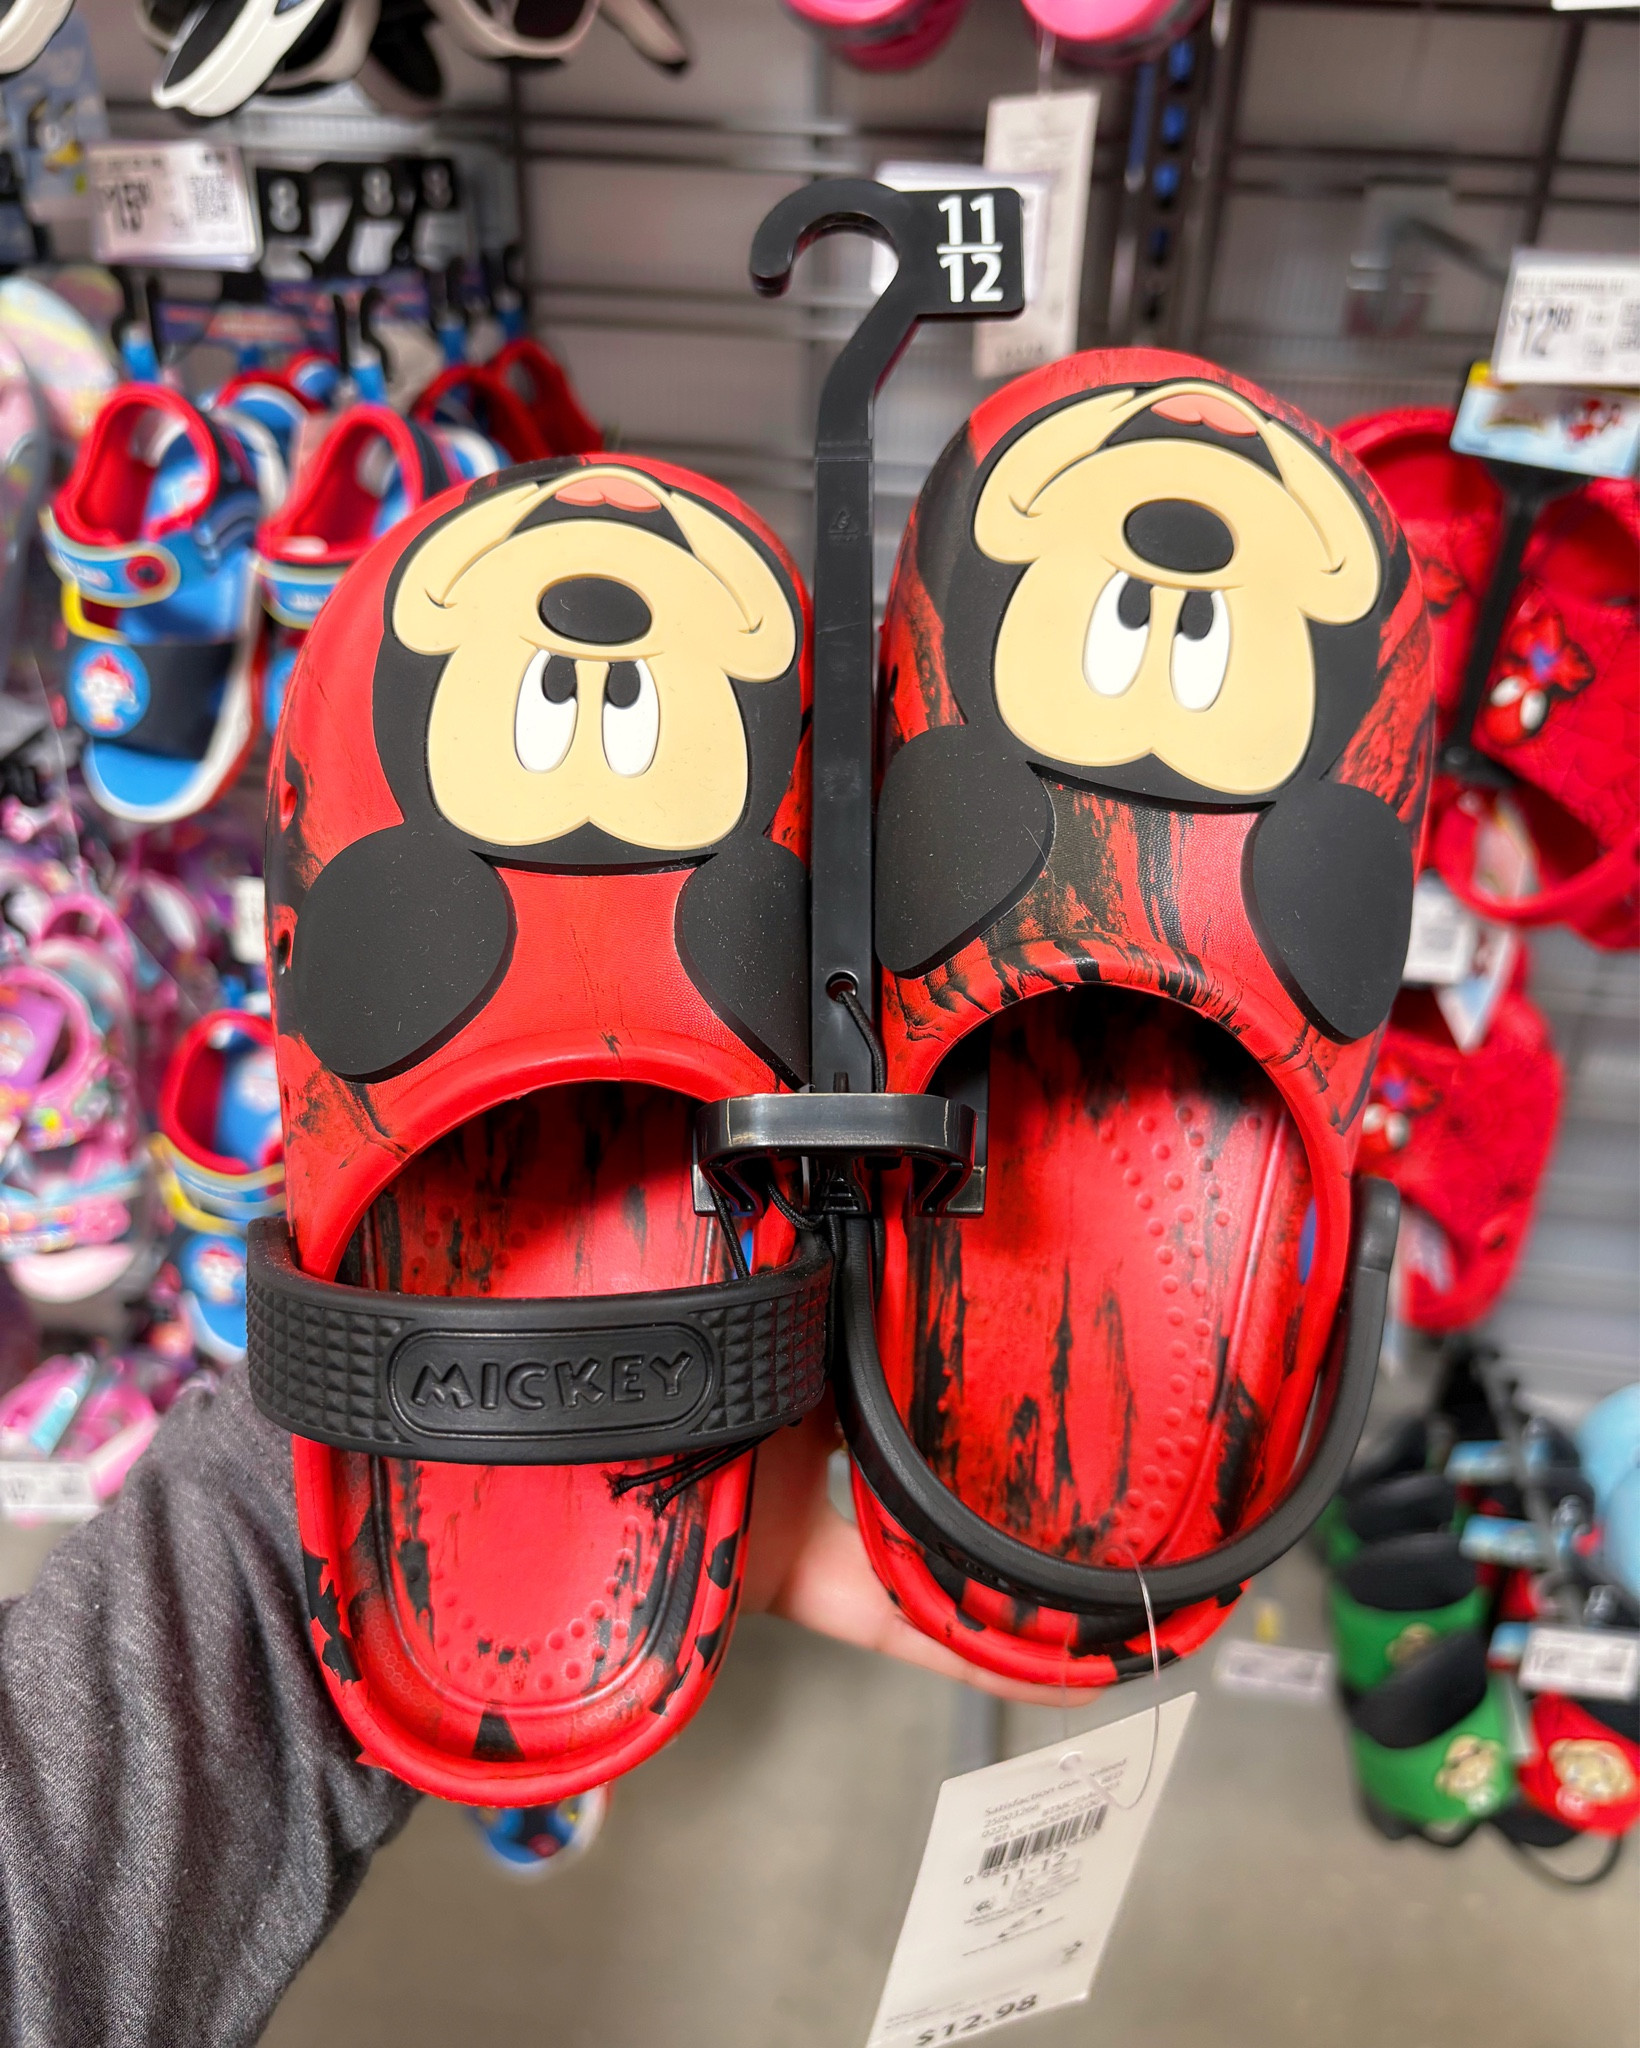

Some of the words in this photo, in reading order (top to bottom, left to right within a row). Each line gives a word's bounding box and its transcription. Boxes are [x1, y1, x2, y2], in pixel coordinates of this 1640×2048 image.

[269, 177, 300, 233] 8
[361, 166, 394, 216] 8
[938, 193, 996, 245] 11
[939, 253, 1004, 303] 12
[411, 1351, 693, 1410] MICKEY
[985, 1786, 1055, 1815] Satisfaction
[1058, 1757, 1127, 1789] Guanteed
[1001, 1851, 1067, 1887] 11-12
[915, 1993, 1038, 2047] $12.98
